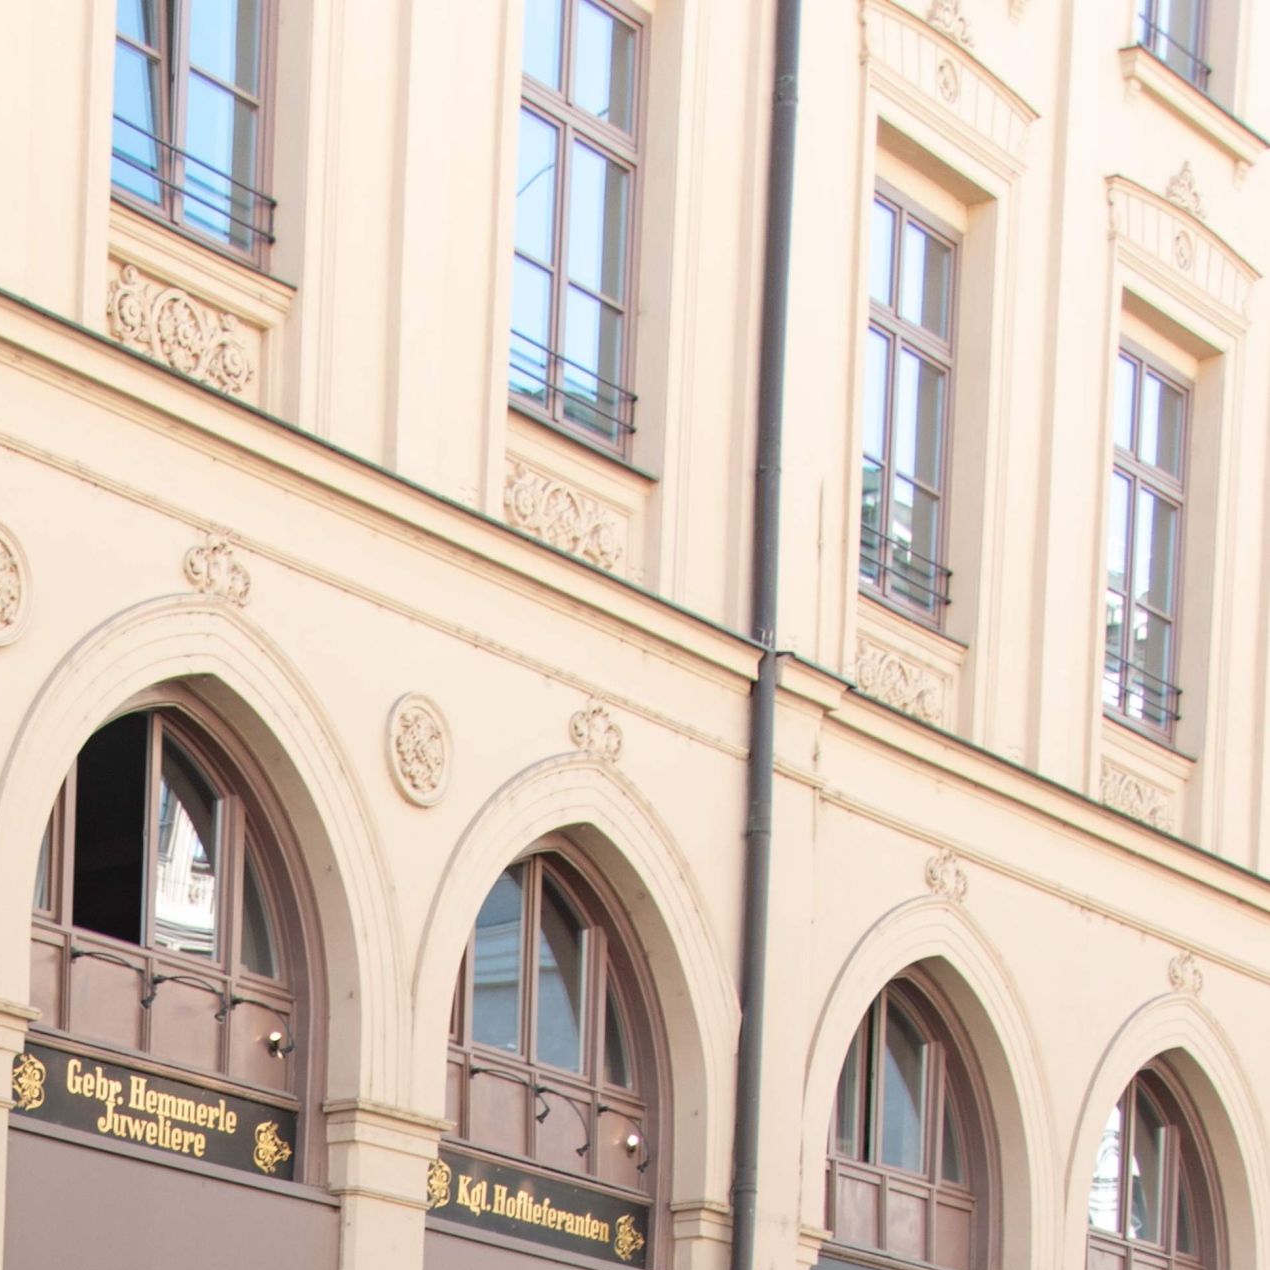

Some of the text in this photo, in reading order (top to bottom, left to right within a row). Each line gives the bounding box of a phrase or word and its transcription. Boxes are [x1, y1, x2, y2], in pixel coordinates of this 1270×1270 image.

[66, 1058, 237, 1134] Gebr. Hemmerle
[97, 1101, 206, 1157] Juweliere
[456, 1174, 610, 1243] Kgl. Hoflieferanten
